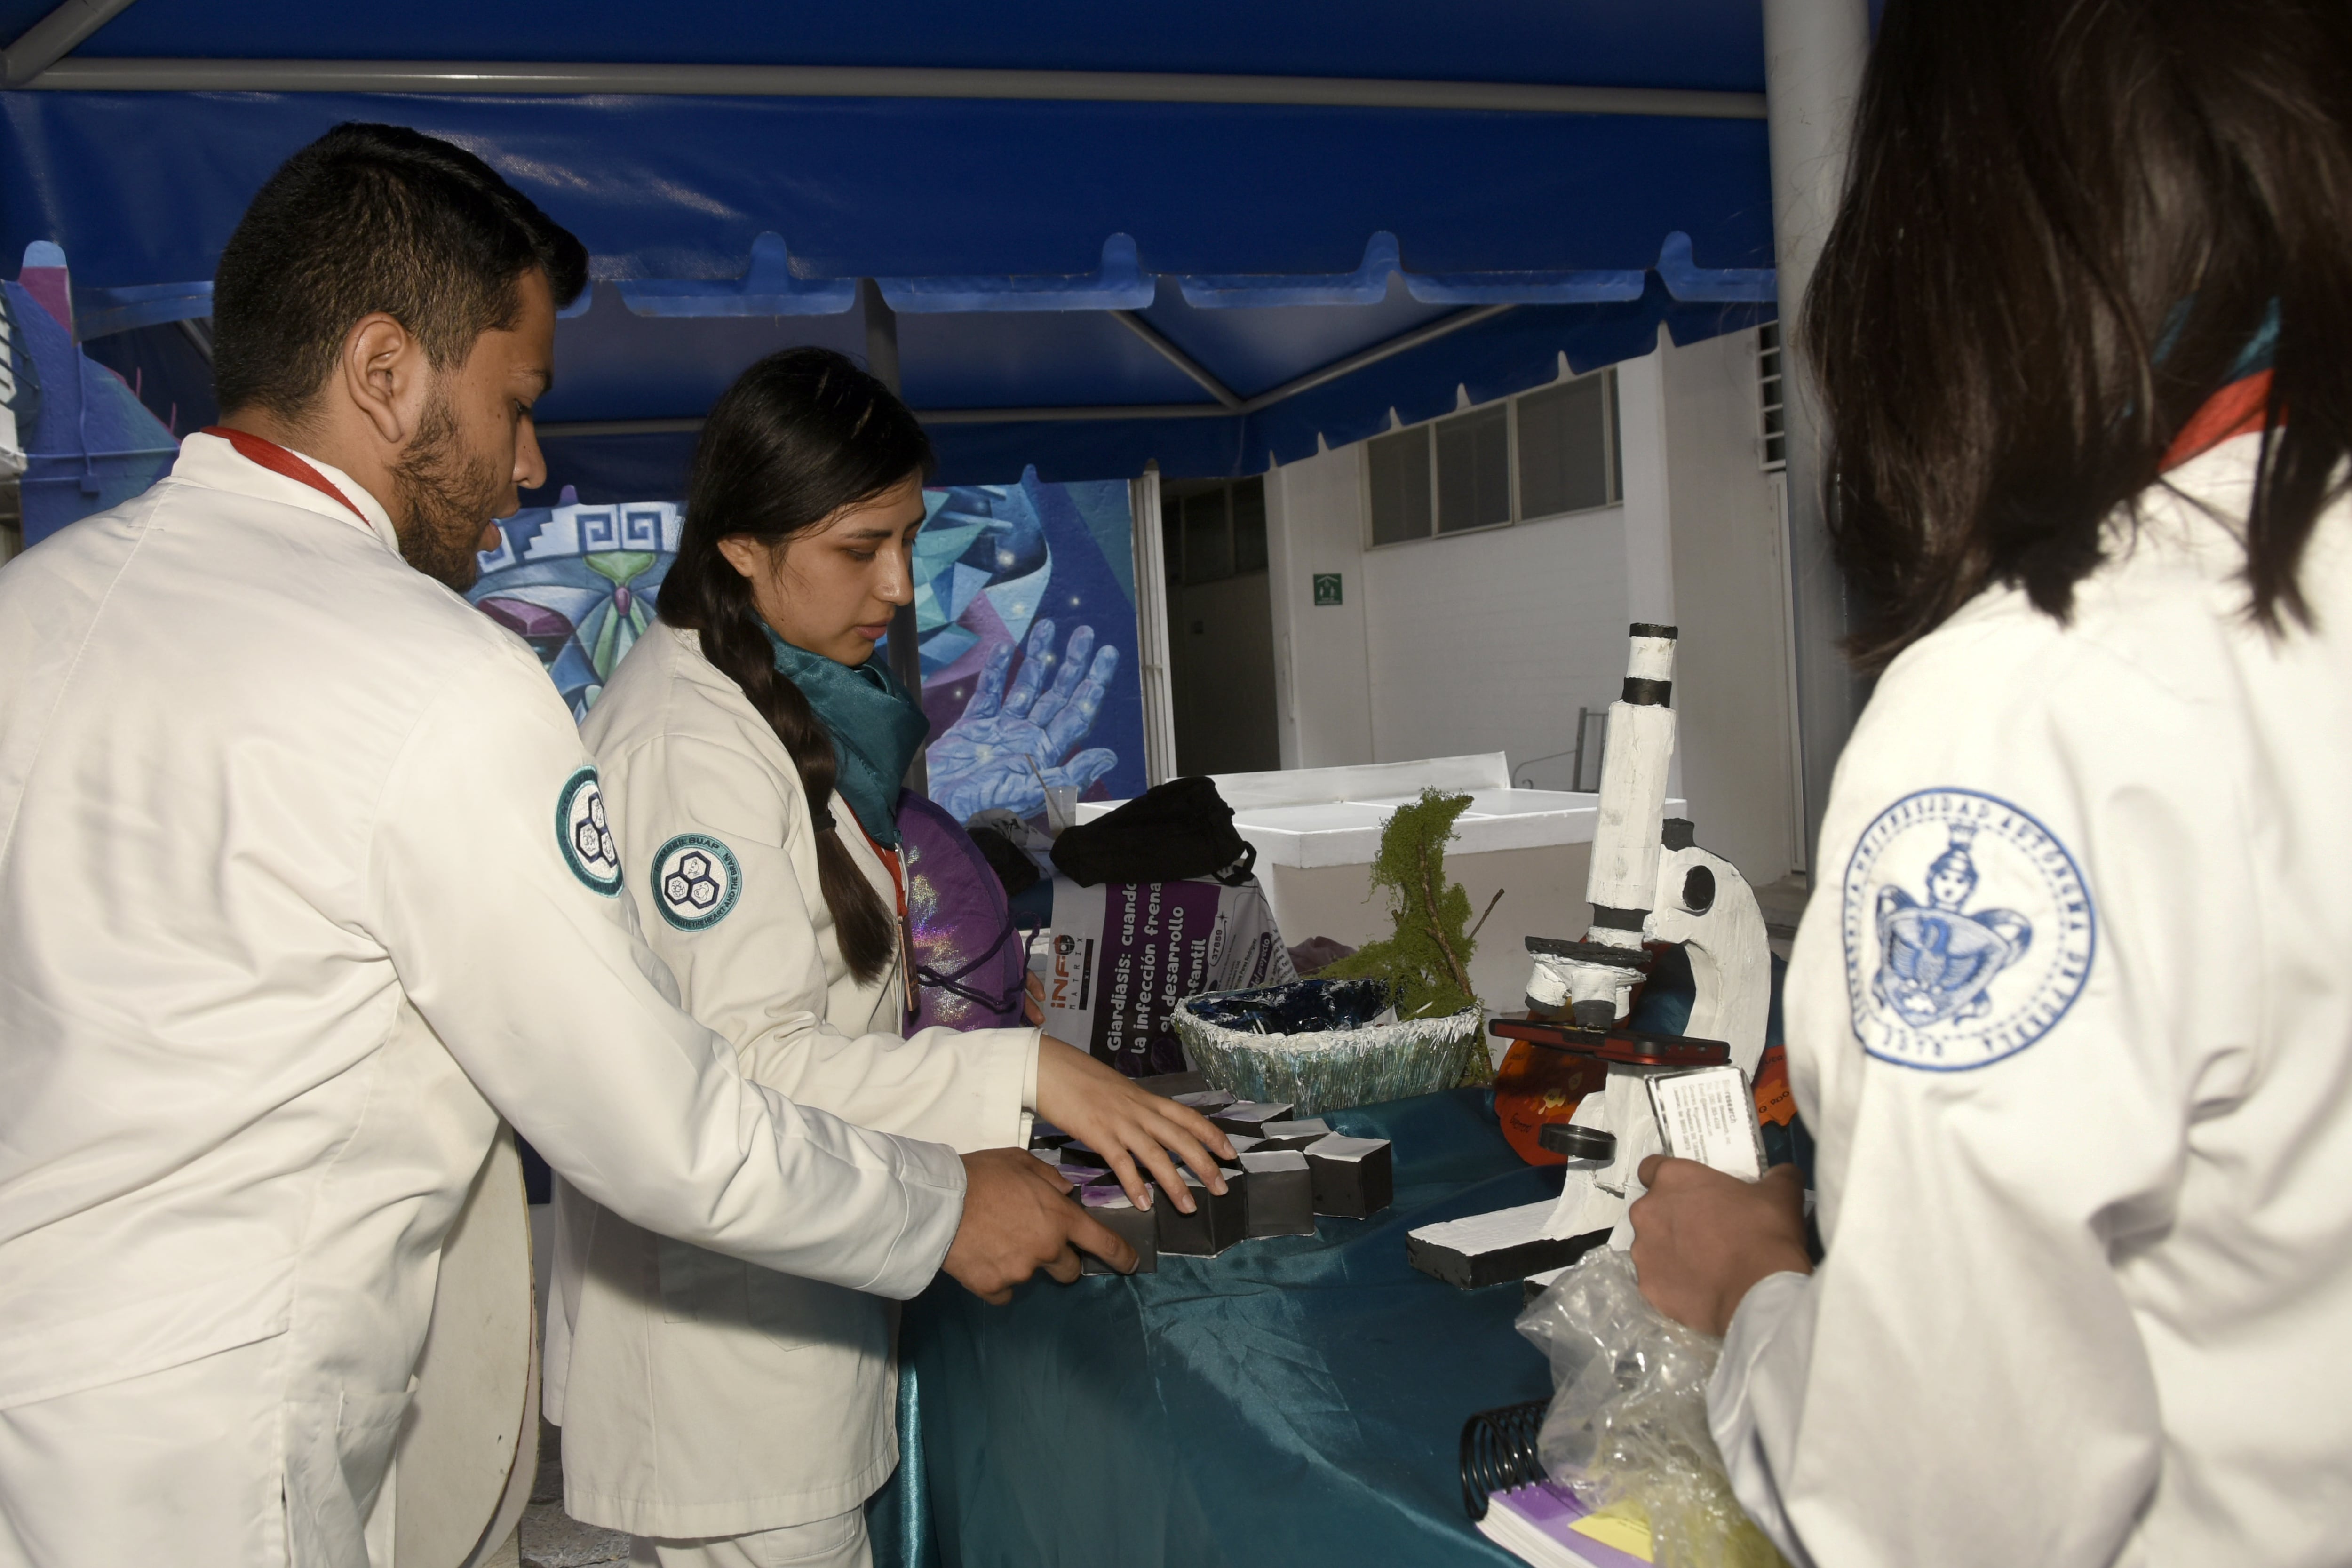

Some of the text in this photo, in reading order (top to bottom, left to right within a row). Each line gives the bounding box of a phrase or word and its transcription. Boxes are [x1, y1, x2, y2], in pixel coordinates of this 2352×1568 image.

[689, 837, 720, 849] BUAP
[723, 852, 738, 876] BRAIN
[724, 891, 736, 908] AND
[730, 876, 738, 890] THE
[705, 907, 726, 926] HEART
[1212, 929, 1223, 960] 37859
[1257, 939, 1271, 975] proyecto
[1069, 938, 1083, 1010] MATRIX
[1130, 883, 1162, 1054] la infección frena
[1160, 907, 1184, 1033] el desarrollo
[1187, 939, 1206, 996] nfantil
[1107, 953, 1131, 1051] Giardiasis:
